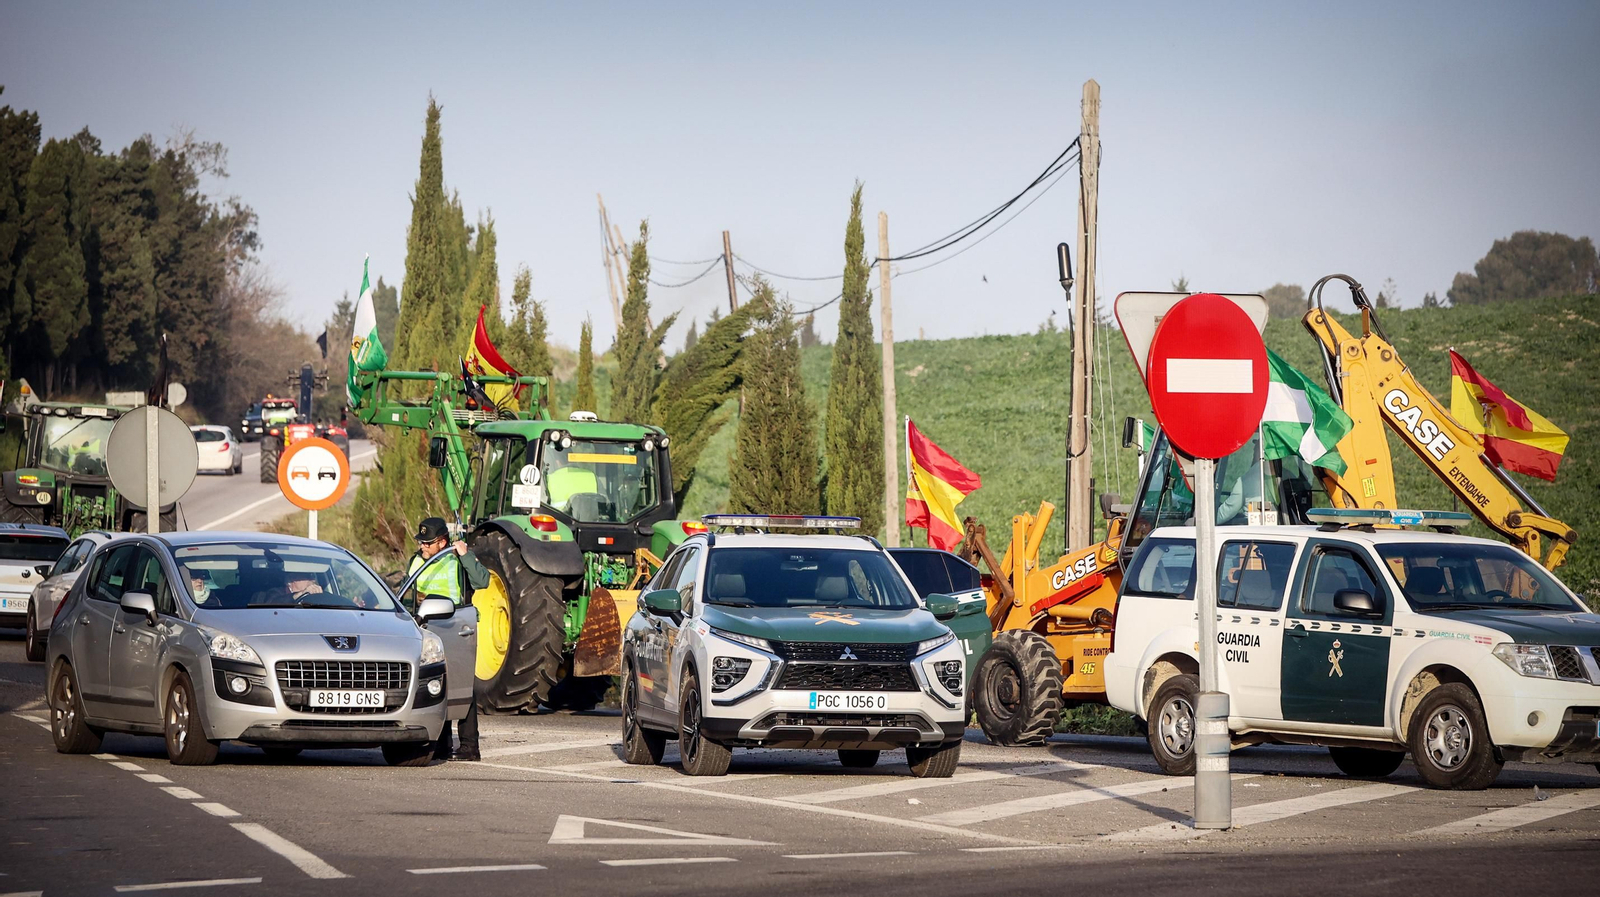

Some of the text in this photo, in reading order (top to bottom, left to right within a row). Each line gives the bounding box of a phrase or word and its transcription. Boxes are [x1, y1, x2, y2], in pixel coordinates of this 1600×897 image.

[1384, 389, 1456, 462] CASE
[524, 467, 537, 484] 40
[1449, 466, 1490, 508] EXTENDAHOE
[38, 493, 48, 502] 40
[1052, 552, 1098, 591] CASE
[7, 600, 27, 608] 9560
[1217, 631, 1261, 648] GUARDIA
[1429, 630, 1455, 639] GUARDIA
[1456, 633, 1471, 641] CIVIL
[1083, 648, 1093, 656] RIDE
[1225, 649, 1250, 663] CIVIL
[1080, 661, 1096, 675] 46
[317, 692, 380, 705] 8819 GNS
[817, 694, 841, 708] PGC
[845, 695, 874, 708] 1056
